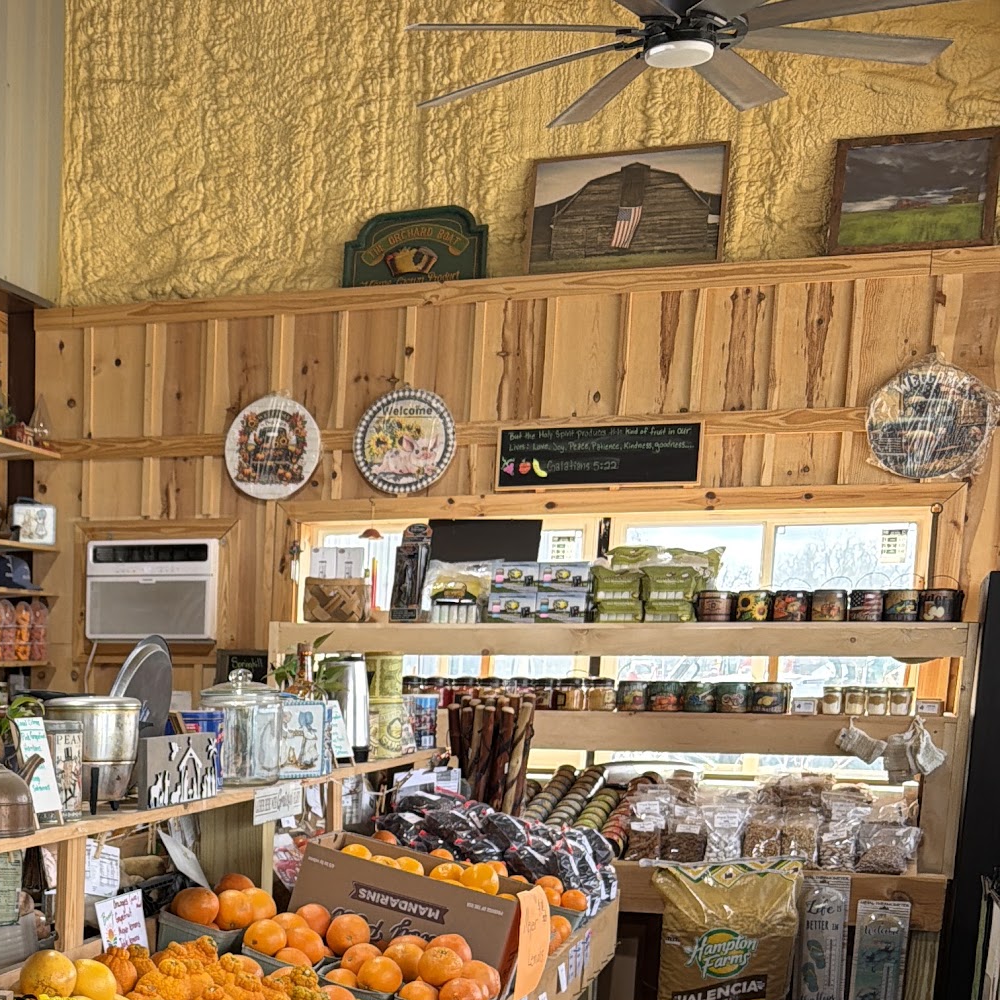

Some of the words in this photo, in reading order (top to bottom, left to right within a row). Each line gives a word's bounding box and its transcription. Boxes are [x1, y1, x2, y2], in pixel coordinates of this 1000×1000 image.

[382, 404, 434, 417] Welcome
[508, 431, 522, 441] But
[525, 432, 536, 440] the
[538, 430, 554, 440] Holy
[555, 429, 575, 440] Spirit
[576, 427, 607, 440] produces
[640, 427, 649, 435] of
[650, 426, 667, 436] fruit
[668, 427, 676, 435] in
[546, 459, 590, 473] Galatians
[592, 460, 618, 472] 5:22
[357, 886, 440, 921] MANDARINS
[806, 898, 836, 916] Life
[806, 919, 830, 931] BETTER
[863, 925, 901, 936] Welcome
[684, 933, 758, 967] Hampton
[700, 951, 752, 980] Farms
